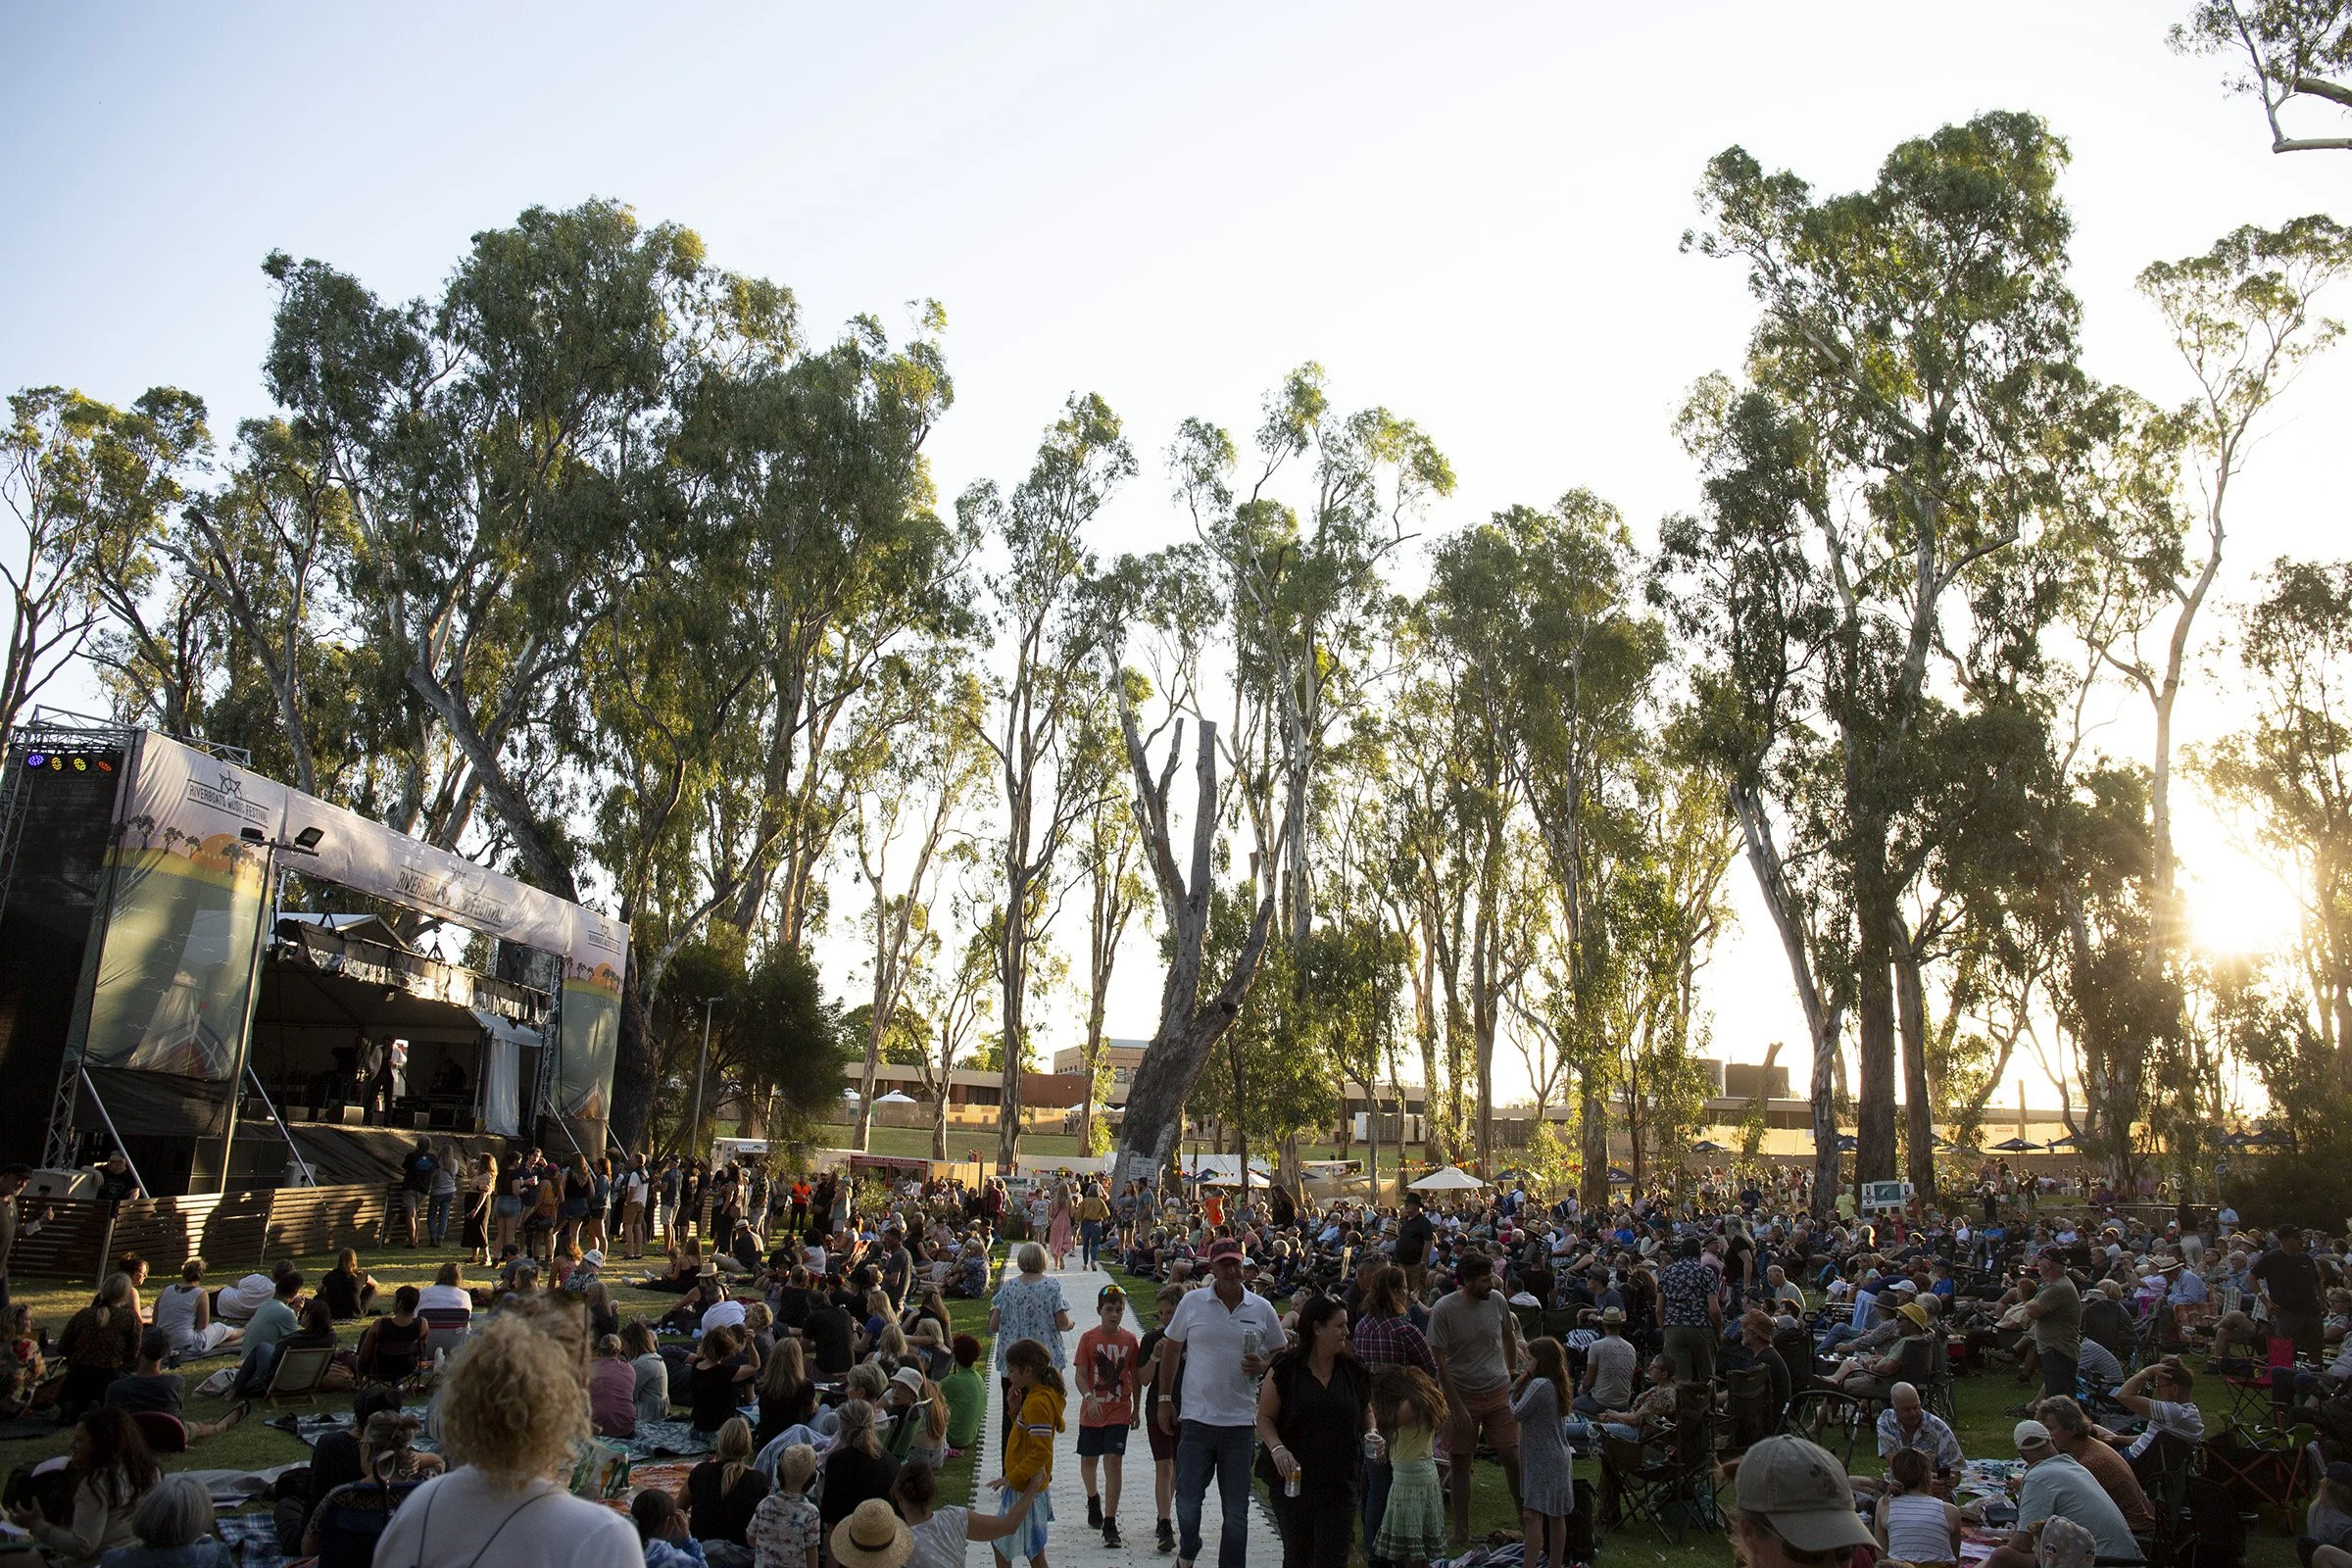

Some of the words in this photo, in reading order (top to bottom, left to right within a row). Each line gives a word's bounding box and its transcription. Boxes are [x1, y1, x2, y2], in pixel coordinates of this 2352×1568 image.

[189, 785, 226, 808] RIVERBOATS
[227, 798, 245, 814] MUSIC
[245, 804, 269, 824] FESTIVAL
[469, 897, 504, 923] FESTIVAL
